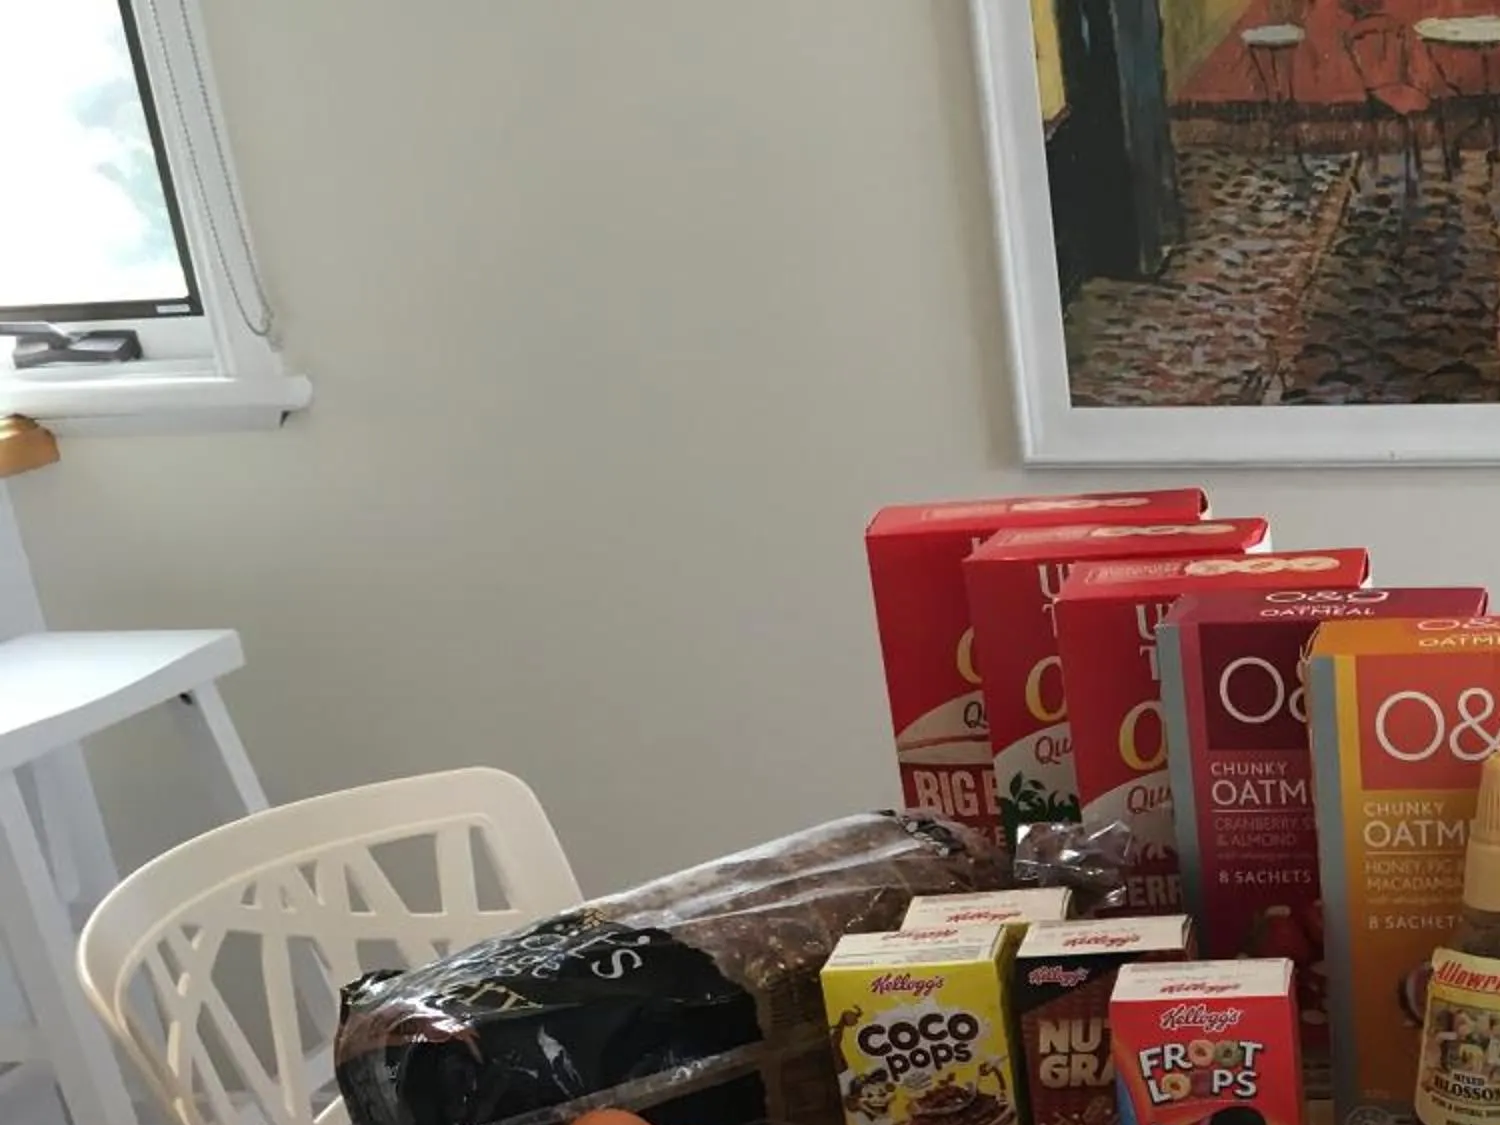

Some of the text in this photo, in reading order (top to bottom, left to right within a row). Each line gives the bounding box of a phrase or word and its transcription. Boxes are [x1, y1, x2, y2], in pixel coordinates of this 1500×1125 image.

[1259, 607, 1376, 617] OATMEAL
[1210, 762, 1288, 776] CHUNKY
[913, 769, 979, 817] BIG
[1363, 801, 1444, 817] CHUNKY
[1219, 869, 1311, 884] 8 SACHETS
[871, 973, 945, 996] Kellogg's
[1029, 966, 1089, 987] Kellogg's
[1160, 1003, 1245, 1032] Kellogg's
[1139, 1039, 1264, 1080] FROOT
